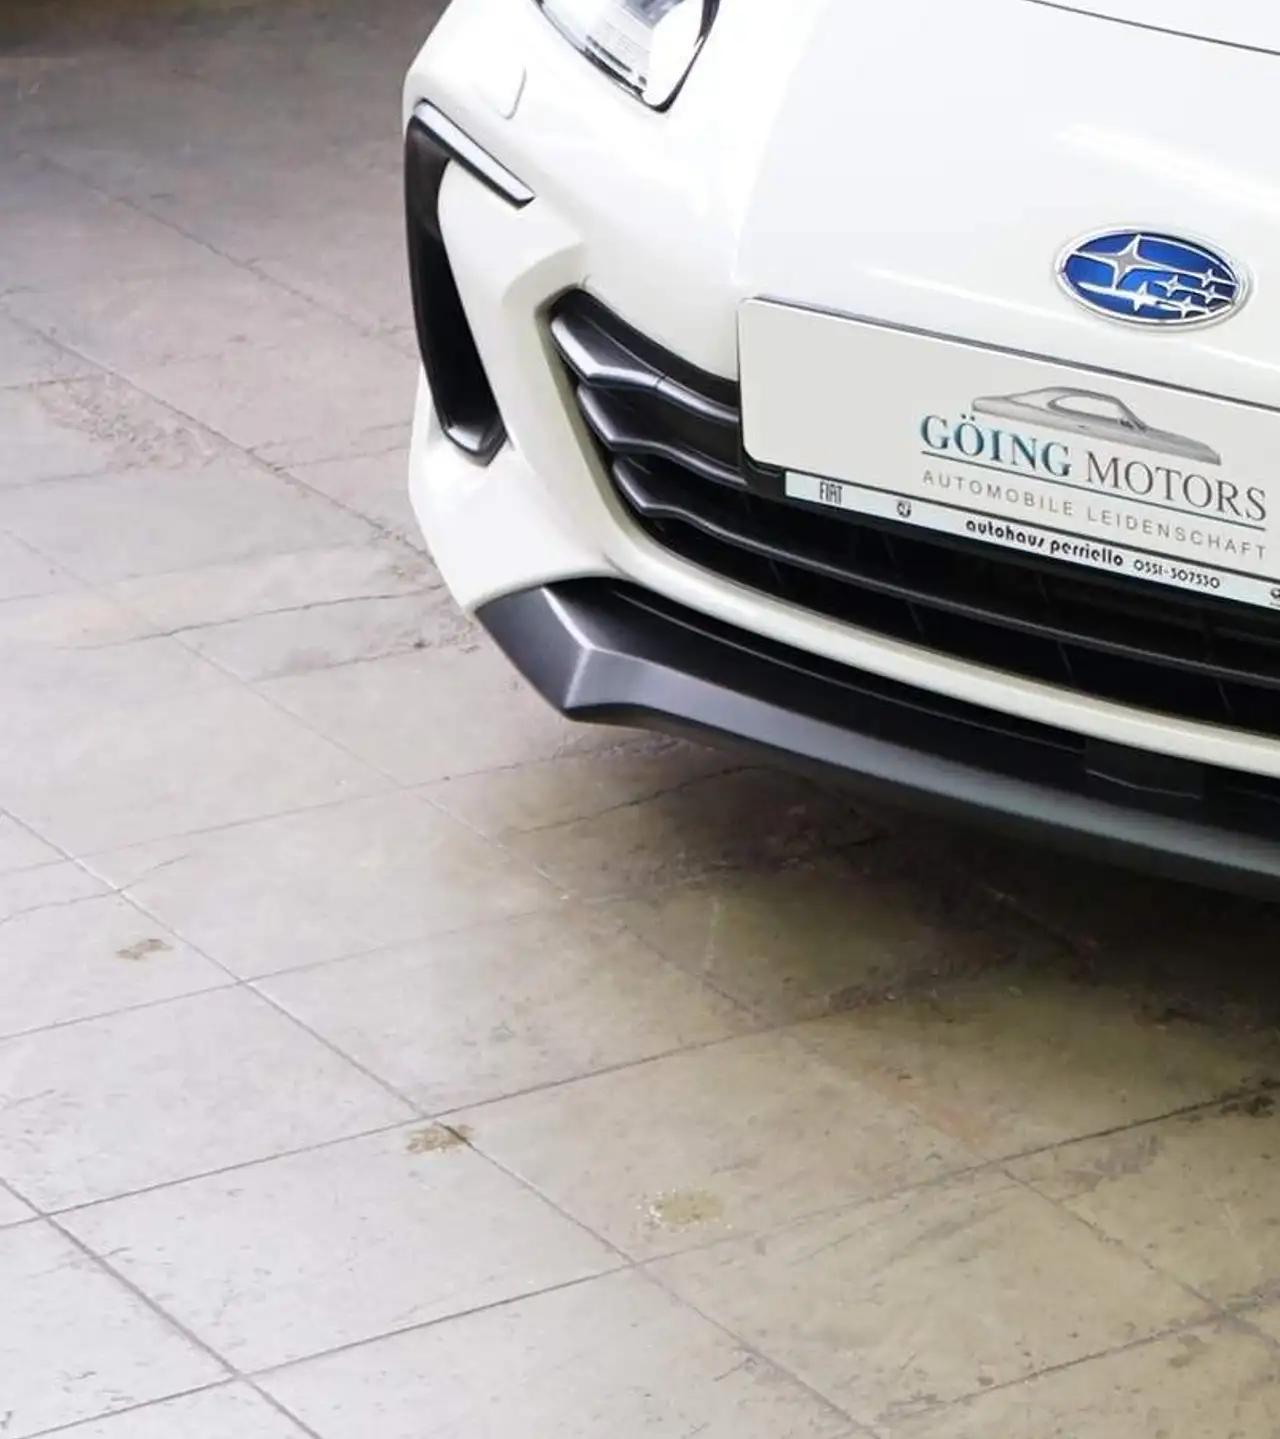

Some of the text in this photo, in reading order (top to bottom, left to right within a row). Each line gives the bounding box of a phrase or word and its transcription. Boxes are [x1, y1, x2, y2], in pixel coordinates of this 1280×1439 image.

[818, 480, 843, 506] FIAT
[920, 413, 1268, 522] GÖING MOTORS
[922, 468, 1267, 561] AUTOMOBILE LEIDENSCHAFT
[965, 519, 1045, 549] autohaus
[1049, 538, 1124, 567] perriello
